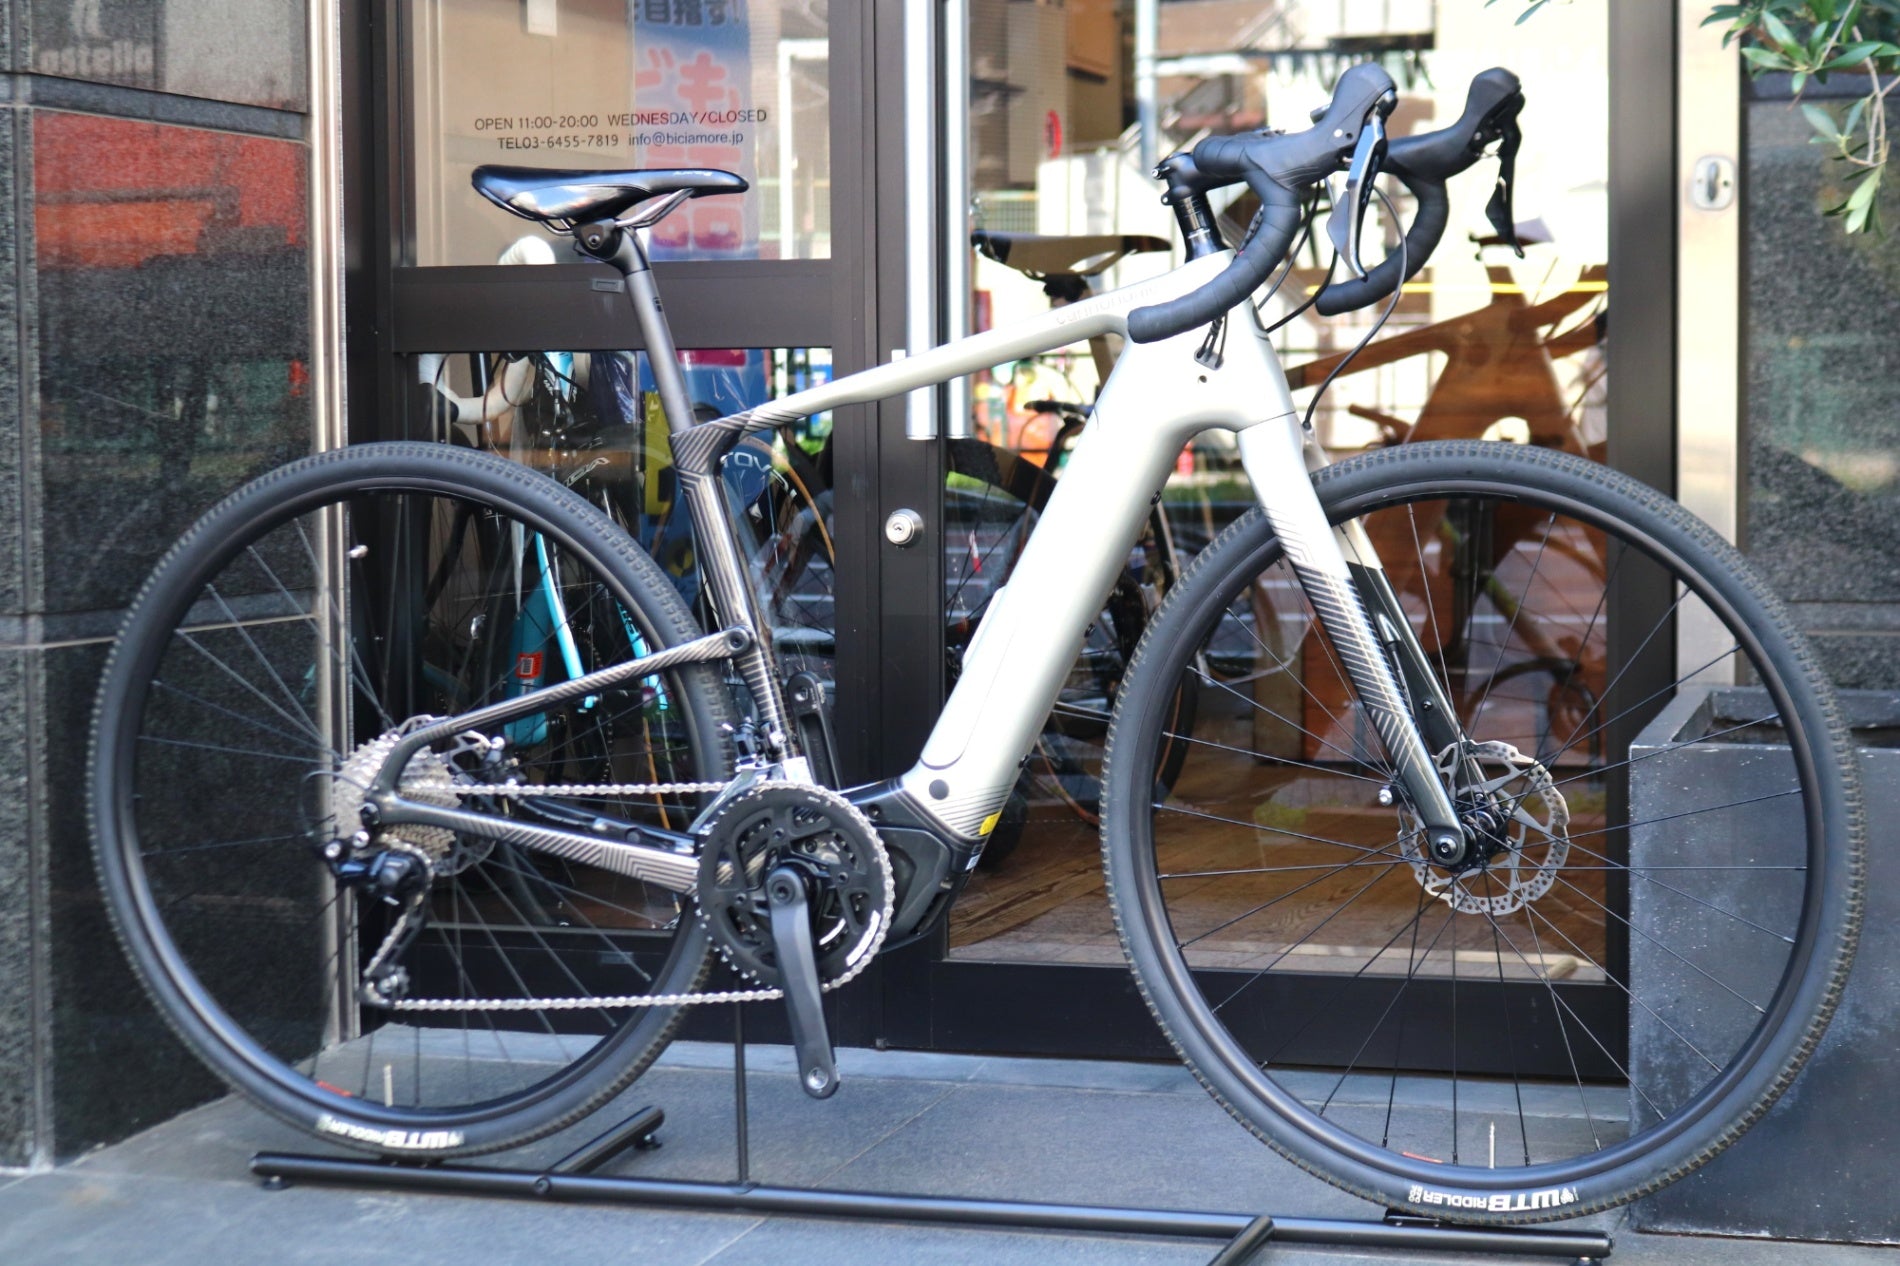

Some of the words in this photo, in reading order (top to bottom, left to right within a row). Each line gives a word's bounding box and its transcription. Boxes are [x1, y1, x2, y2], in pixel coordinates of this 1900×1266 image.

[474, 118, 513, 130] OPEN
[519, 114, 598, 129] 11:00-20:00
[607, 109, 767, 127] WEDNESDAY/CLOSED
[628, 131, 744, 147] info@biciamore.jp
[1422, 1190, 1488, 1209] RIDDLER
[1487, 1188, 1562, 1212] WTB
